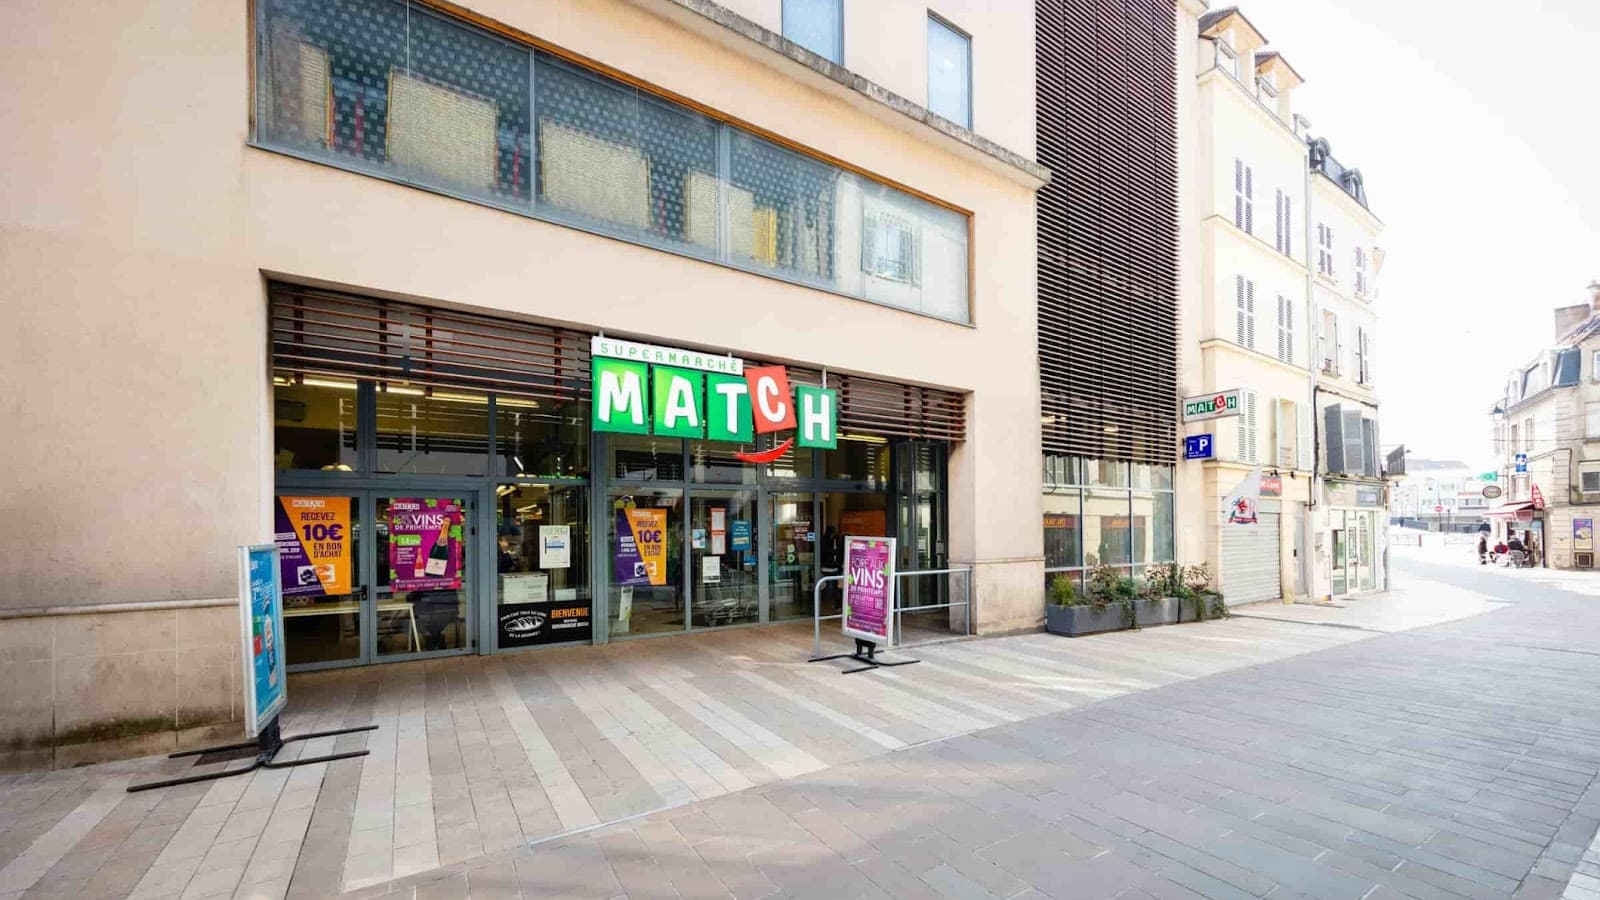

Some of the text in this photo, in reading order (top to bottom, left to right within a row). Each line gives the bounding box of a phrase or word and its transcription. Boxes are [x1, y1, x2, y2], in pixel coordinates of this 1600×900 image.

[600, 342, 737, 372] SUPERMARCHÉ
[598, 369, 831, 442] MATCH
[1187, 396, 1236, 415] MATCH
[1199, 438, 1209, 452] P
[301, 511, 335, 521] RECEVEZ
[411, 514, 444, 525] VINS
[302, 523, 344, 541] 10€
[637, 529, 662, 543] 10€
[313, 542, 342, 551] EN BON
[313, 550, 342, 558] D'ACHAT
[869, 559, 885, 570] AUX
[851, 566, 884, 589] VINS
[551, 607, 590, 618] BIENVENUE
